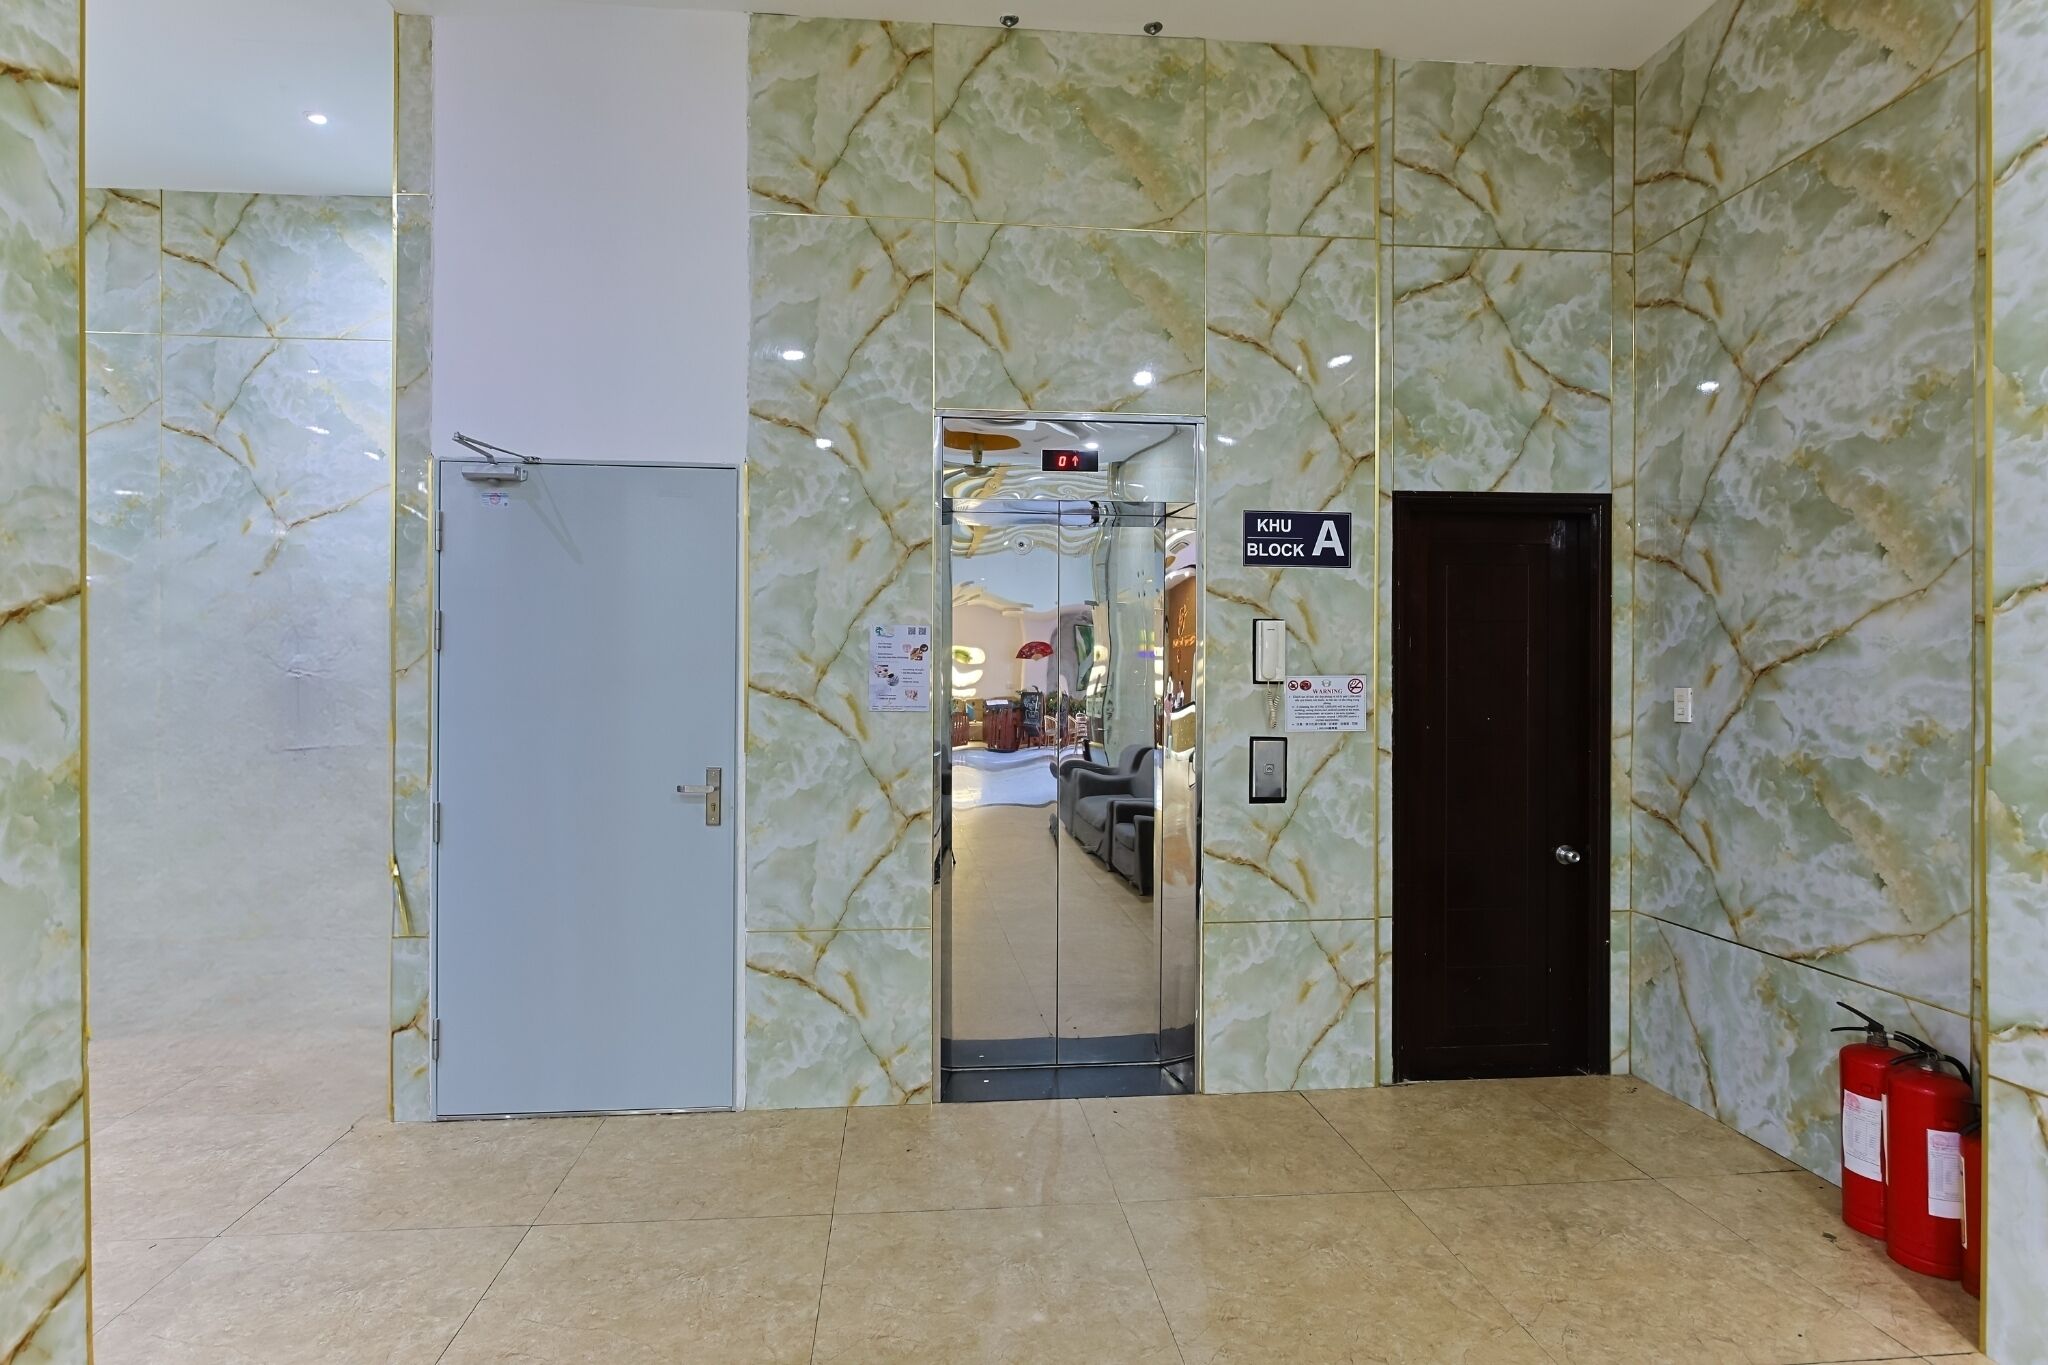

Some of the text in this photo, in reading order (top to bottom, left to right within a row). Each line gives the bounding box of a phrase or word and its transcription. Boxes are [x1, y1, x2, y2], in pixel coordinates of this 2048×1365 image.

[1058, 455, 1067, 467] 0
[1257, 518, 1292, 532] KHU
[1312, 520, 1345, 557] A
[1247, 542, 1305, 557] BLOCK
